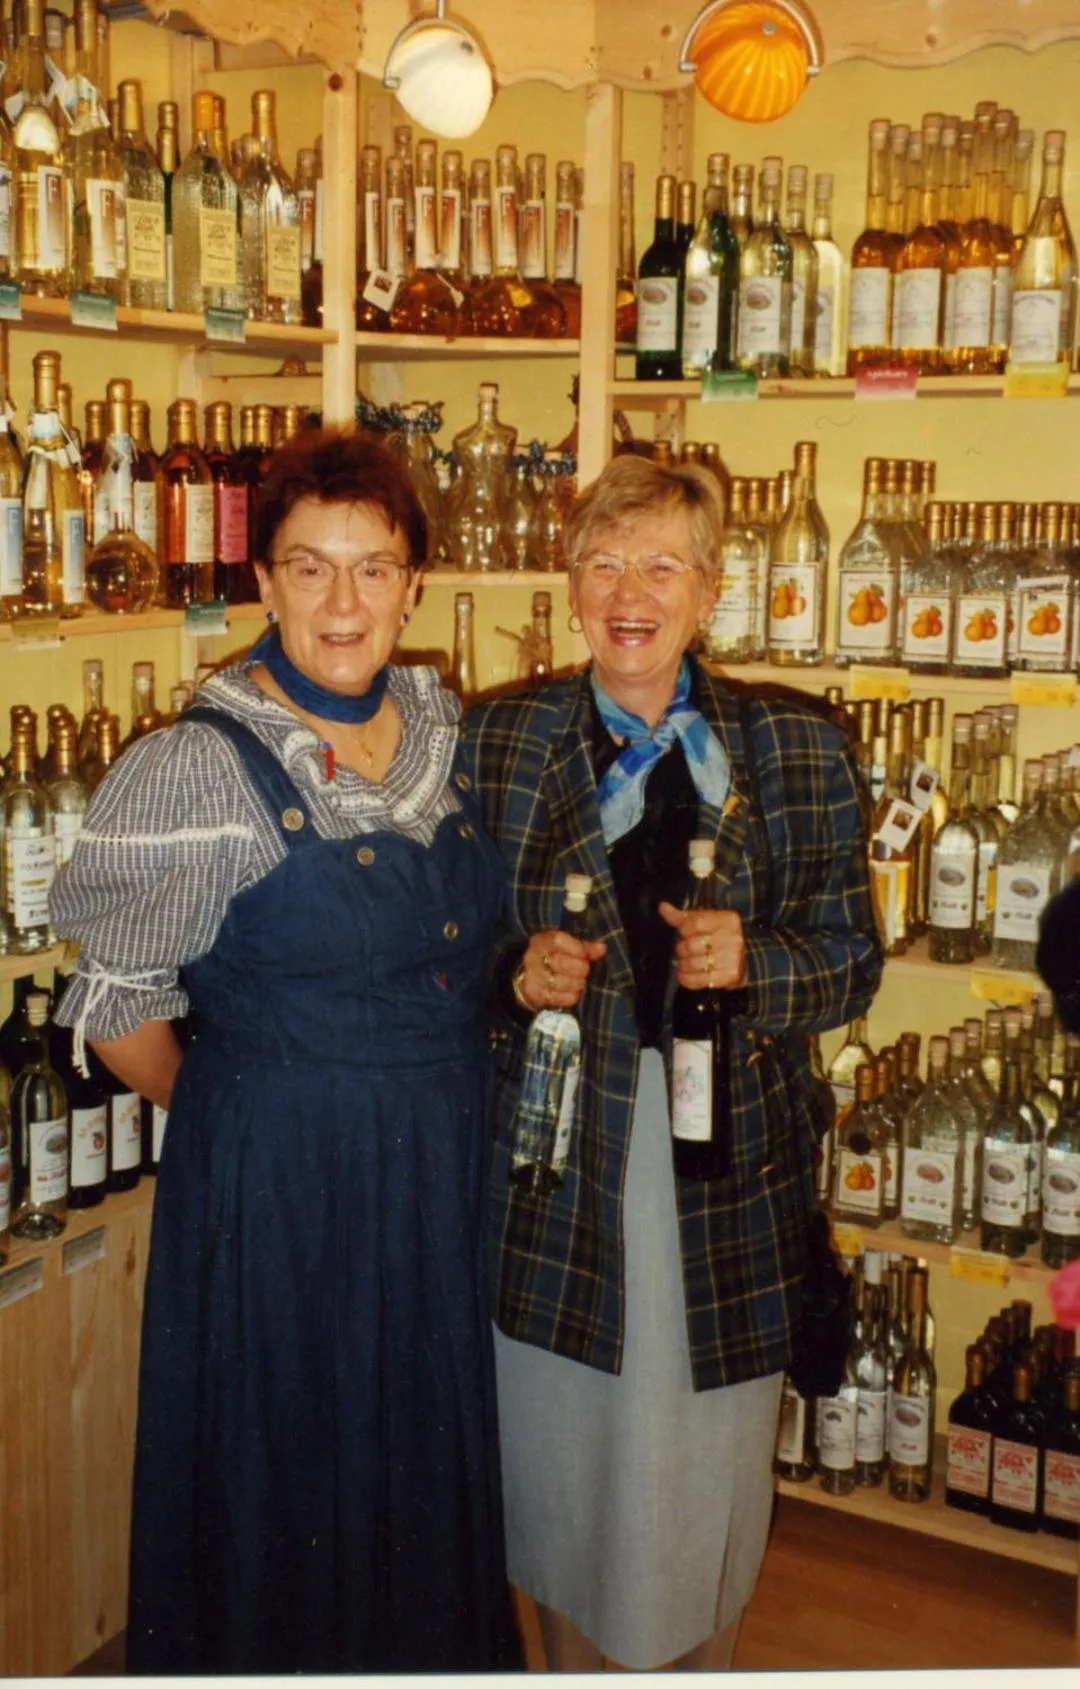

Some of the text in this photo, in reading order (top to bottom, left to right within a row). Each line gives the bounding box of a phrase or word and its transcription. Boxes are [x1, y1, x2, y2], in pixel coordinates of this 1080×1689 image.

[48, 176, 58, 203] F
[102, 190, 111, 216] F
[502, 195, 511, 215] F
